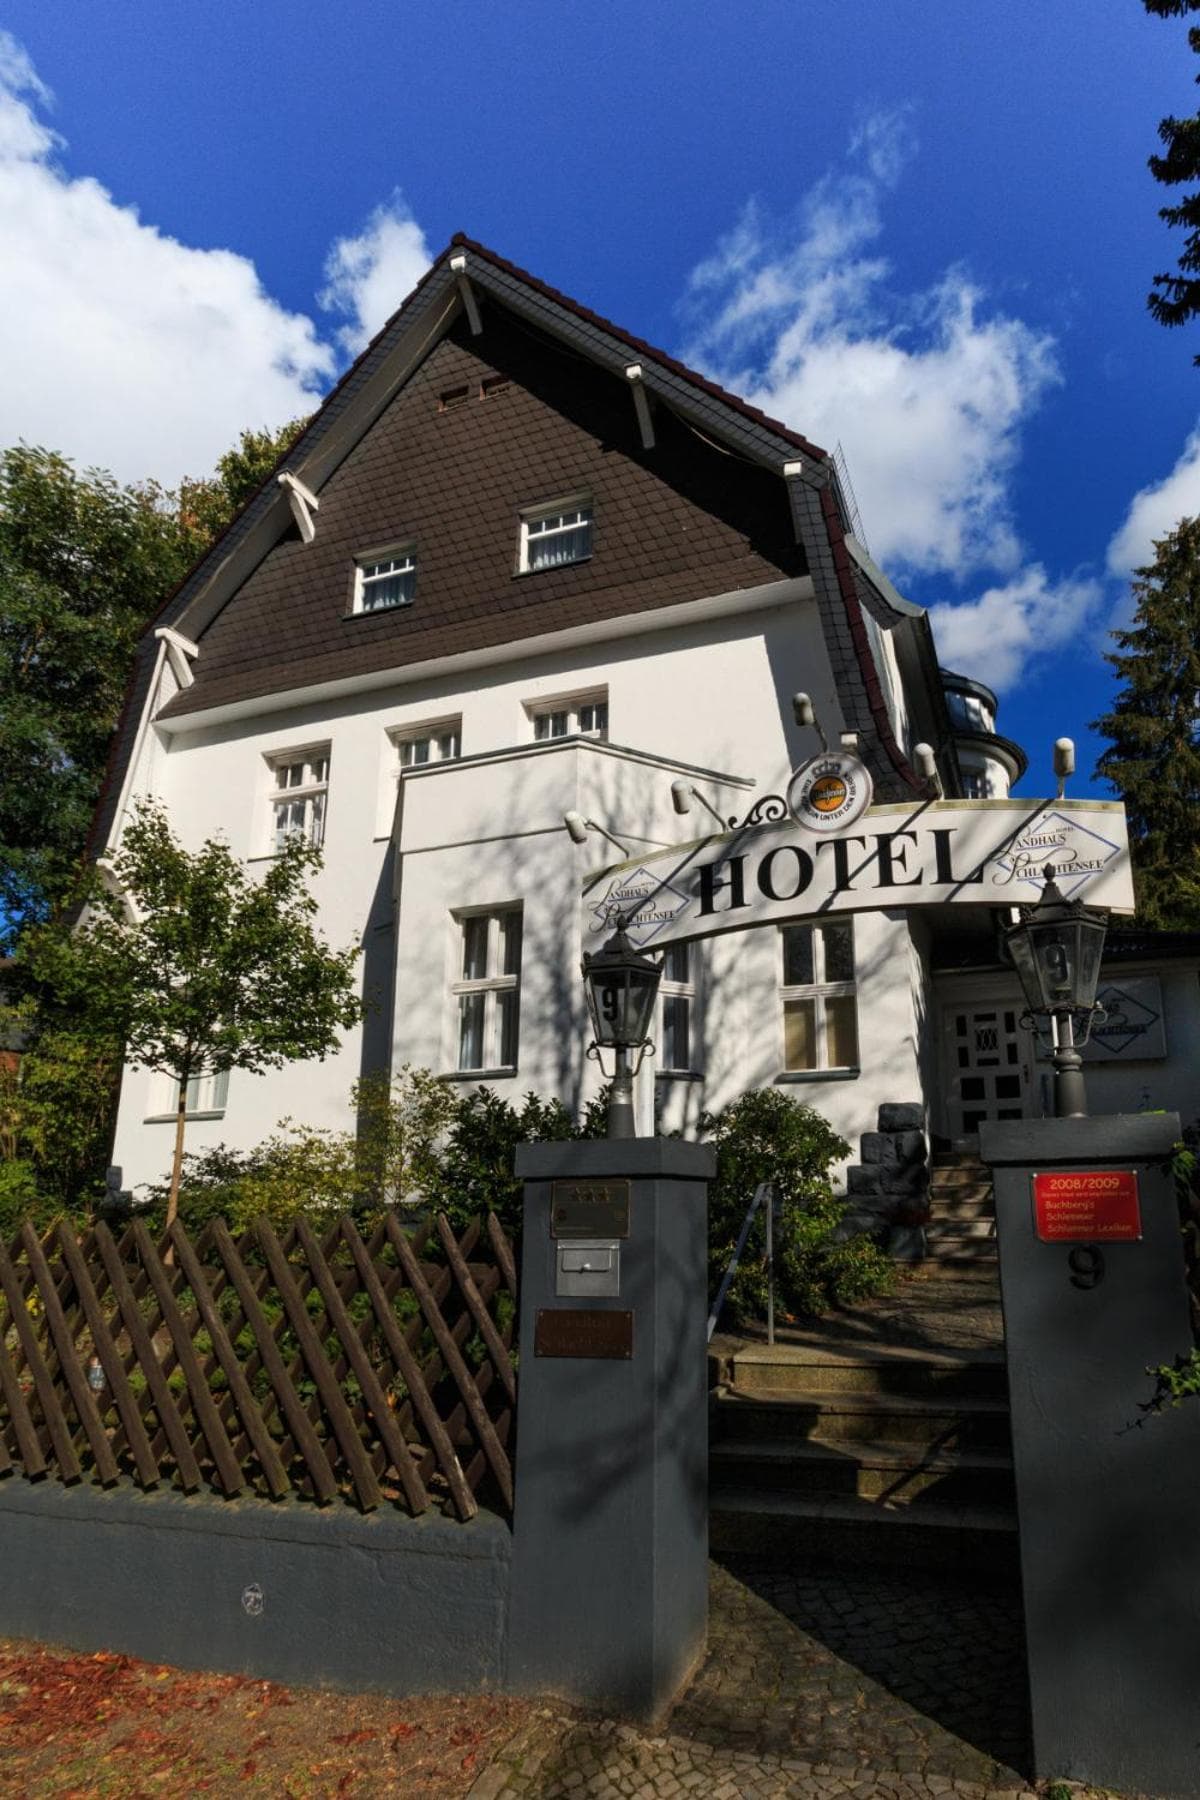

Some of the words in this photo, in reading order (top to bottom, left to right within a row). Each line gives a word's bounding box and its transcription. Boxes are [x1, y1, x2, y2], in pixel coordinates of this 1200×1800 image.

[819, 809, 844, 821] UNTER
[843, 797, 855, 811] DEN
[693, 828, 985, 918] HOTEL
[992, 848, 1104, 885] SCHLHTENSEE
[587, 879, 649, 911] LANDHAUS
[601, 987, 619, 1021] 9
[1049, 1178, 1120, 1190] 2008/2009
[1068, 1246, 1105, 1290] 9
